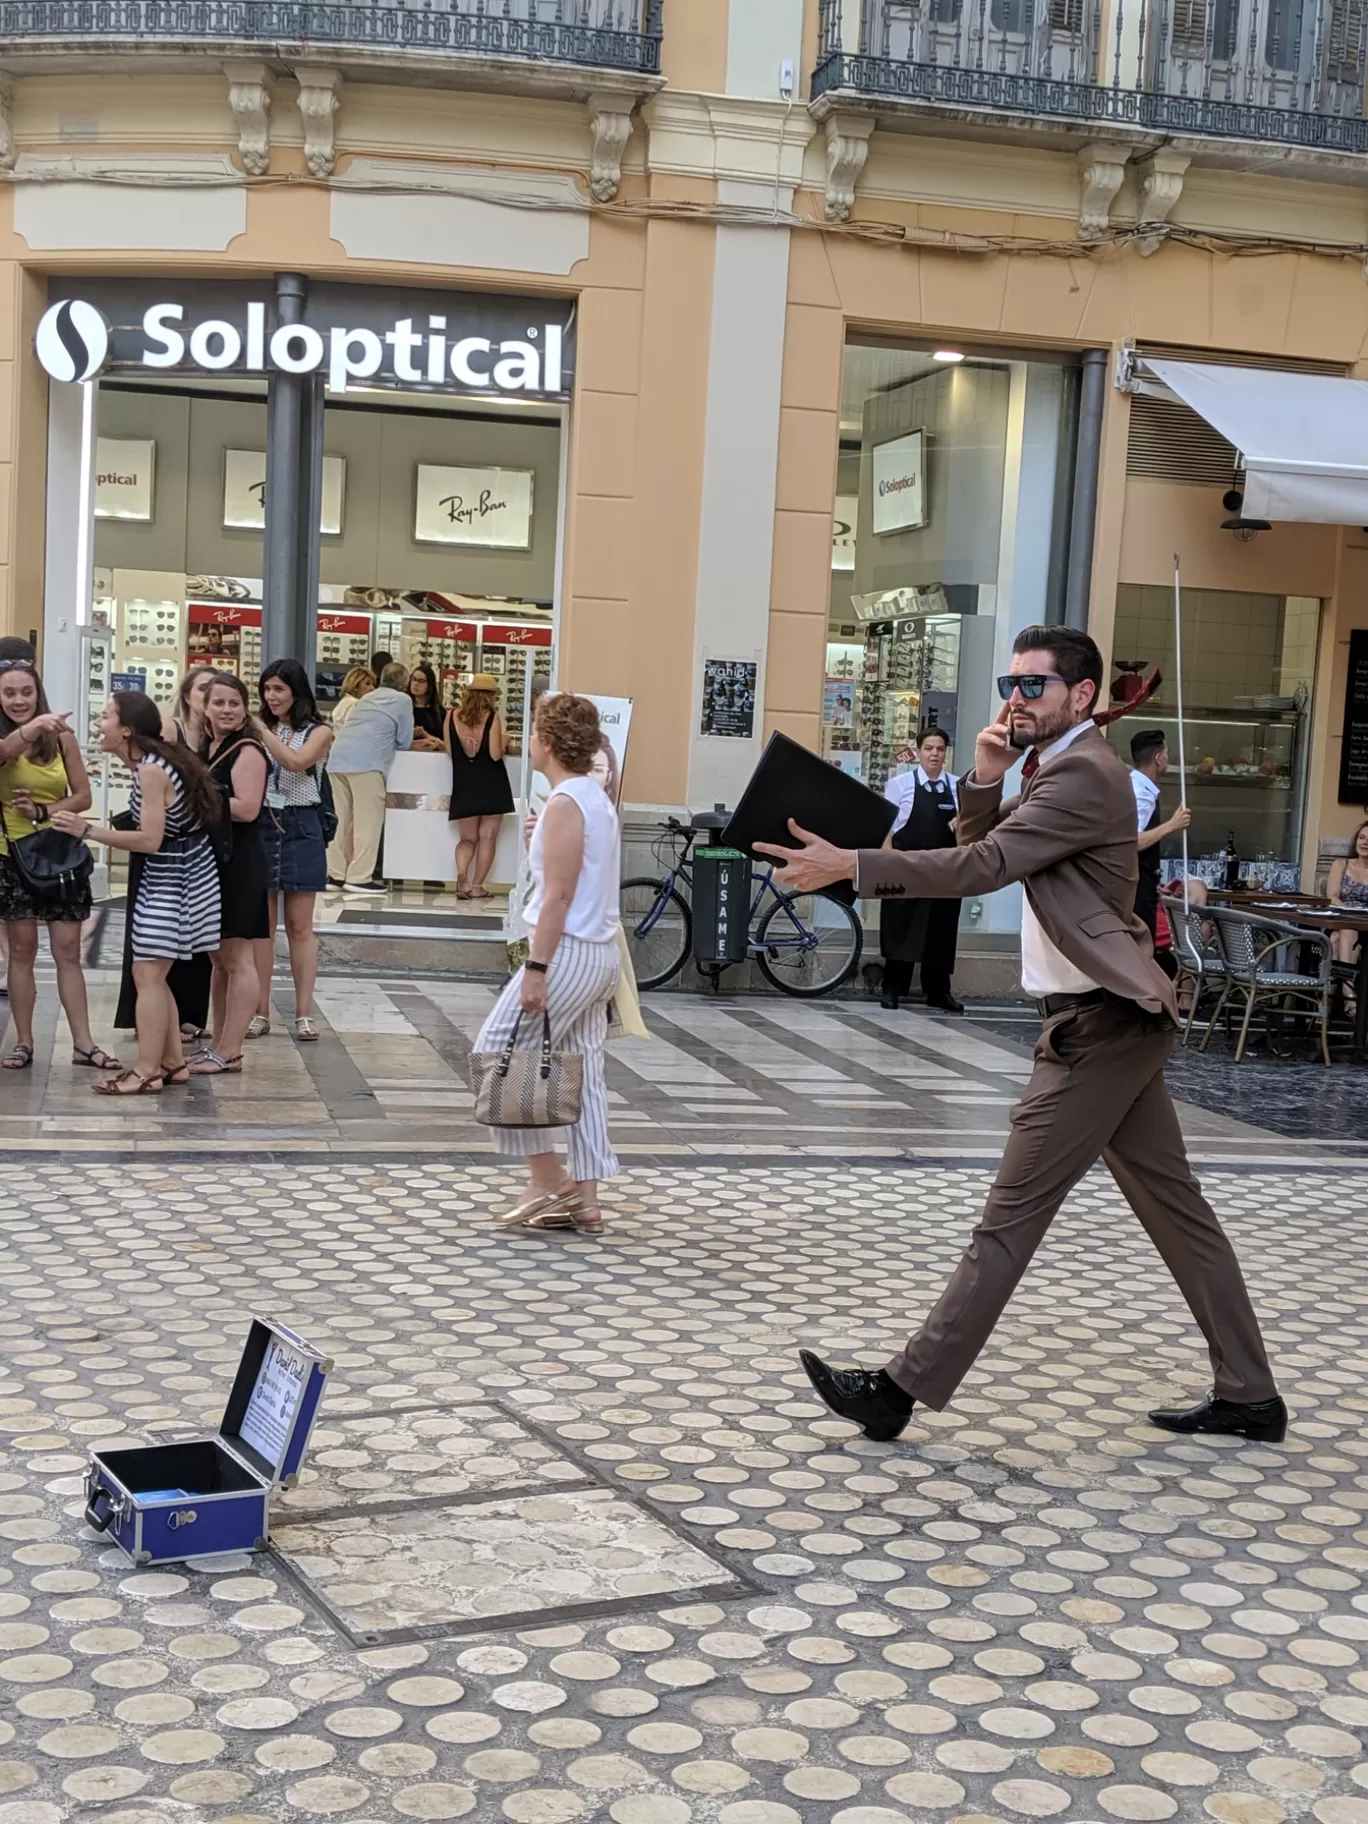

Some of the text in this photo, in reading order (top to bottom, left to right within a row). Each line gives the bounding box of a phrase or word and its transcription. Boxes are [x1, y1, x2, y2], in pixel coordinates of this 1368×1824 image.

[142, 302, 562, 393] Soloptical
[95, 472, 137, 486] ptical
[886, 472, 916, 494] Soloptical
[438, 489, 507, 525] Ray-Ban
